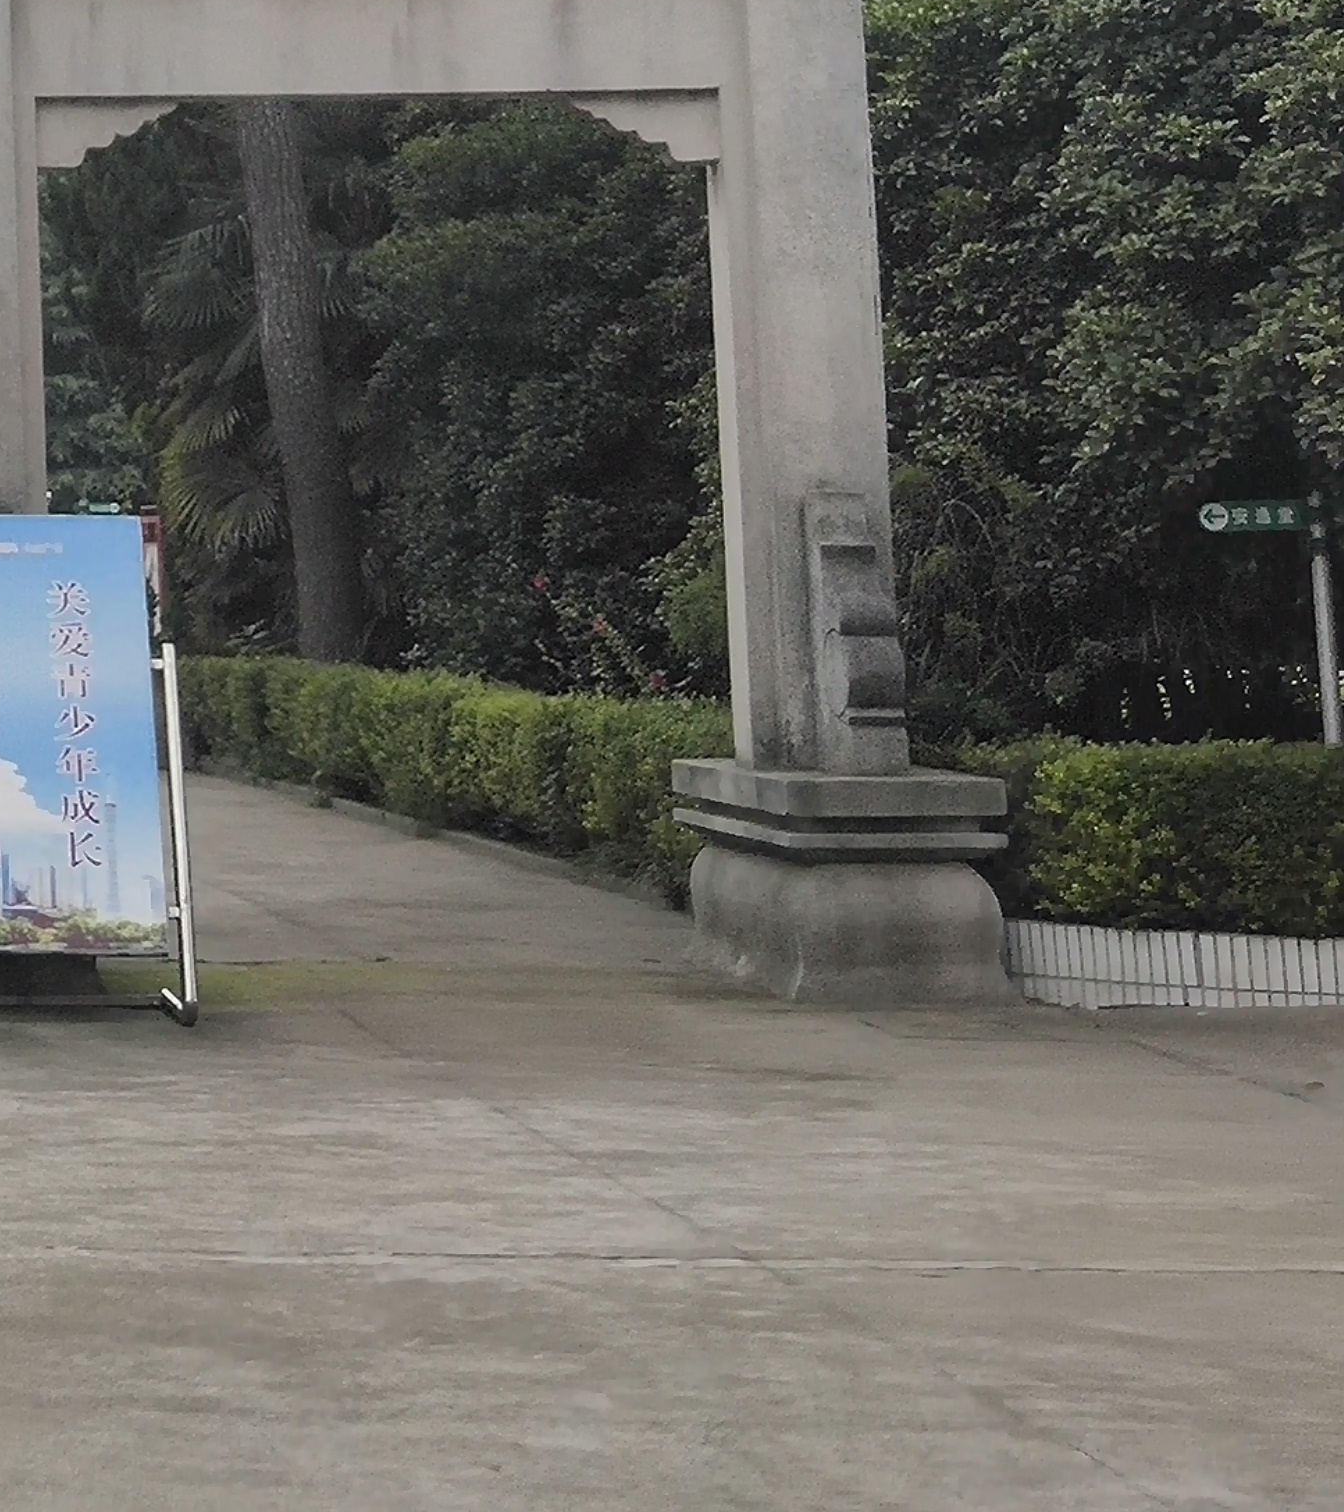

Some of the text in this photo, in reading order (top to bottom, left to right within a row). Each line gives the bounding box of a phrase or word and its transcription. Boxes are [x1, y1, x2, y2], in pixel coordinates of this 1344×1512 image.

[46, 579, 103, 869] 关爱青少年成长
